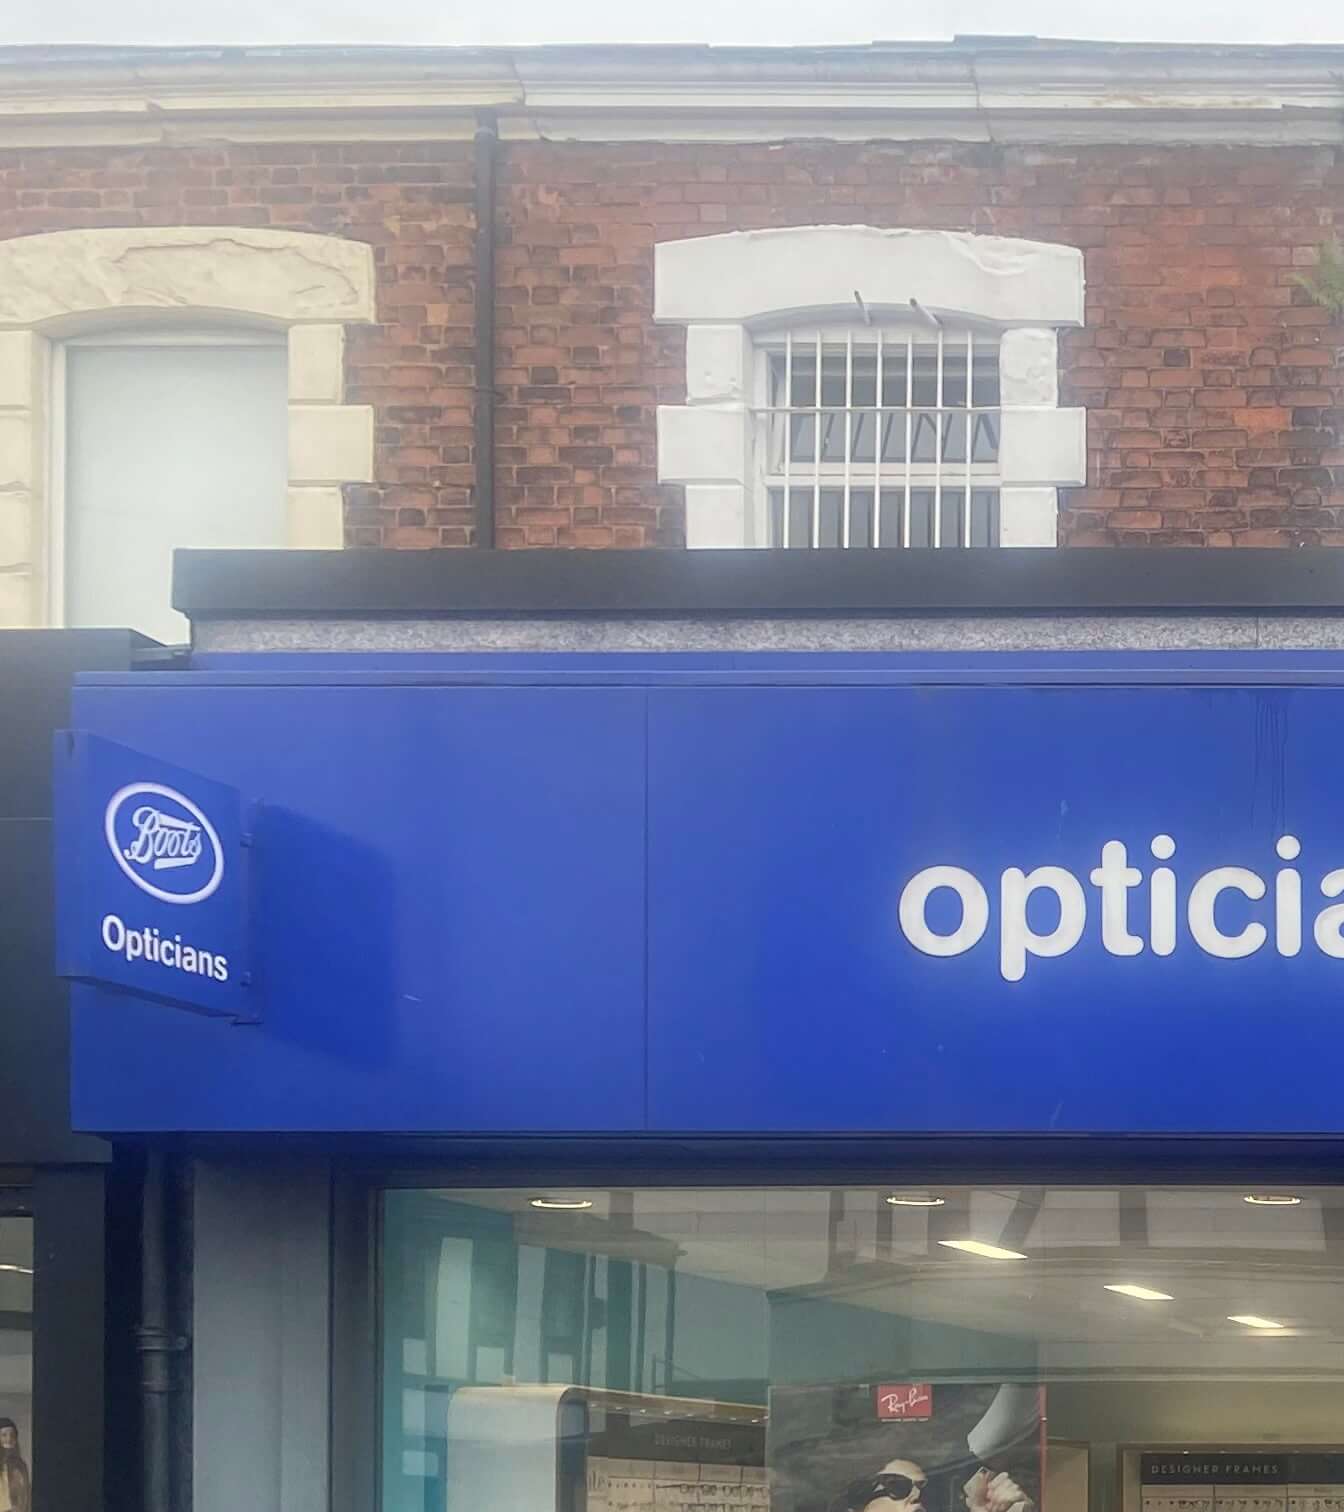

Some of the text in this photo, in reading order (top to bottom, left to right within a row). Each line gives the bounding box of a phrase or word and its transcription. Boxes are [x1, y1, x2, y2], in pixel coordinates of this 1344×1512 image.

[124, 806, 202, 870] Boots
[102, 914, 229, 982] Opticians
[881, 1387, 929, 1413] Ray-Ban
[1151, 1464, 1280, 1475] DESIGNER FRAMES
